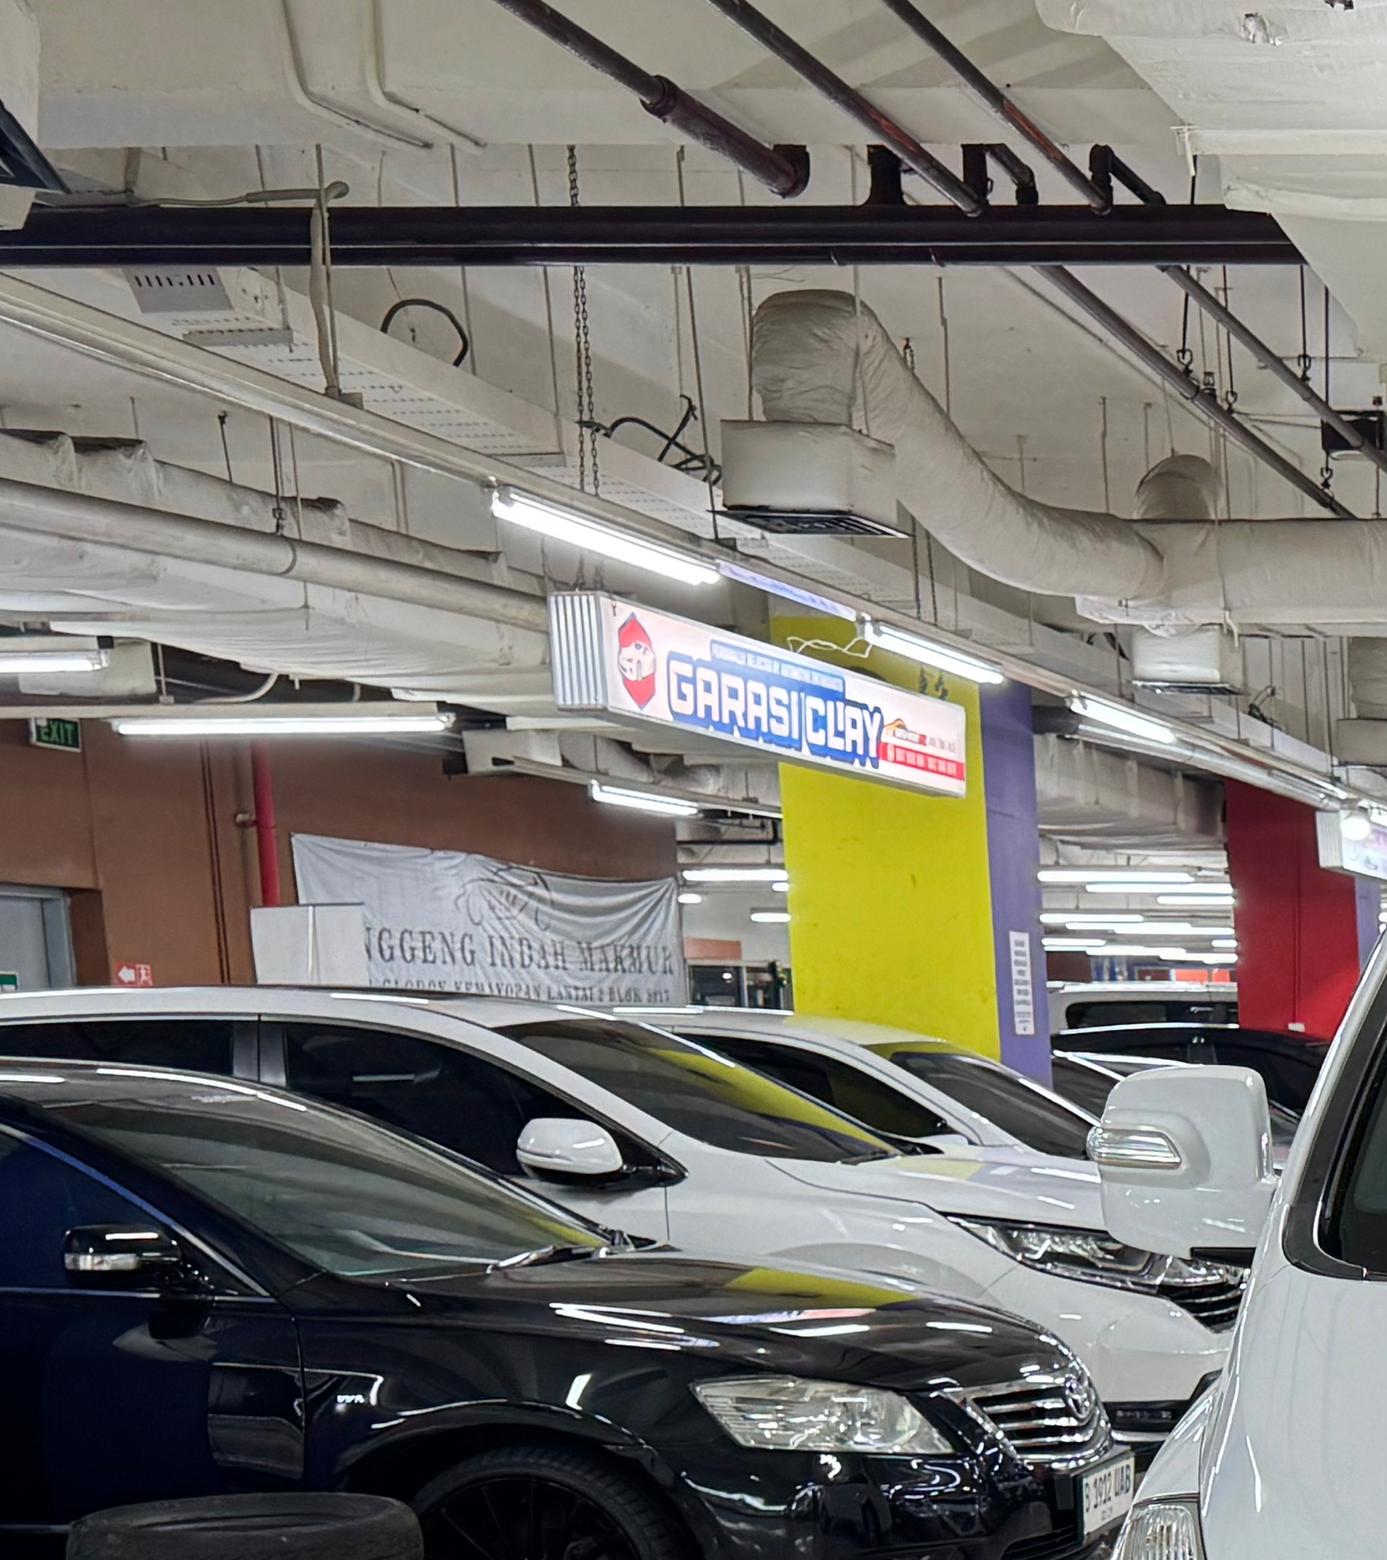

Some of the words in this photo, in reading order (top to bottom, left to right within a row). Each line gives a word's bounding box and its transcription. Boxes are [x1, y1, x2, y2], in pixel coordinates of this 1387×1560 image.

[669, 659, 801, 741] GARASI
[41, 720, 75, 746] EXIT
[488, 934, 569, 971] INDAH
[576, 941, 674, 975] MAKMUR
